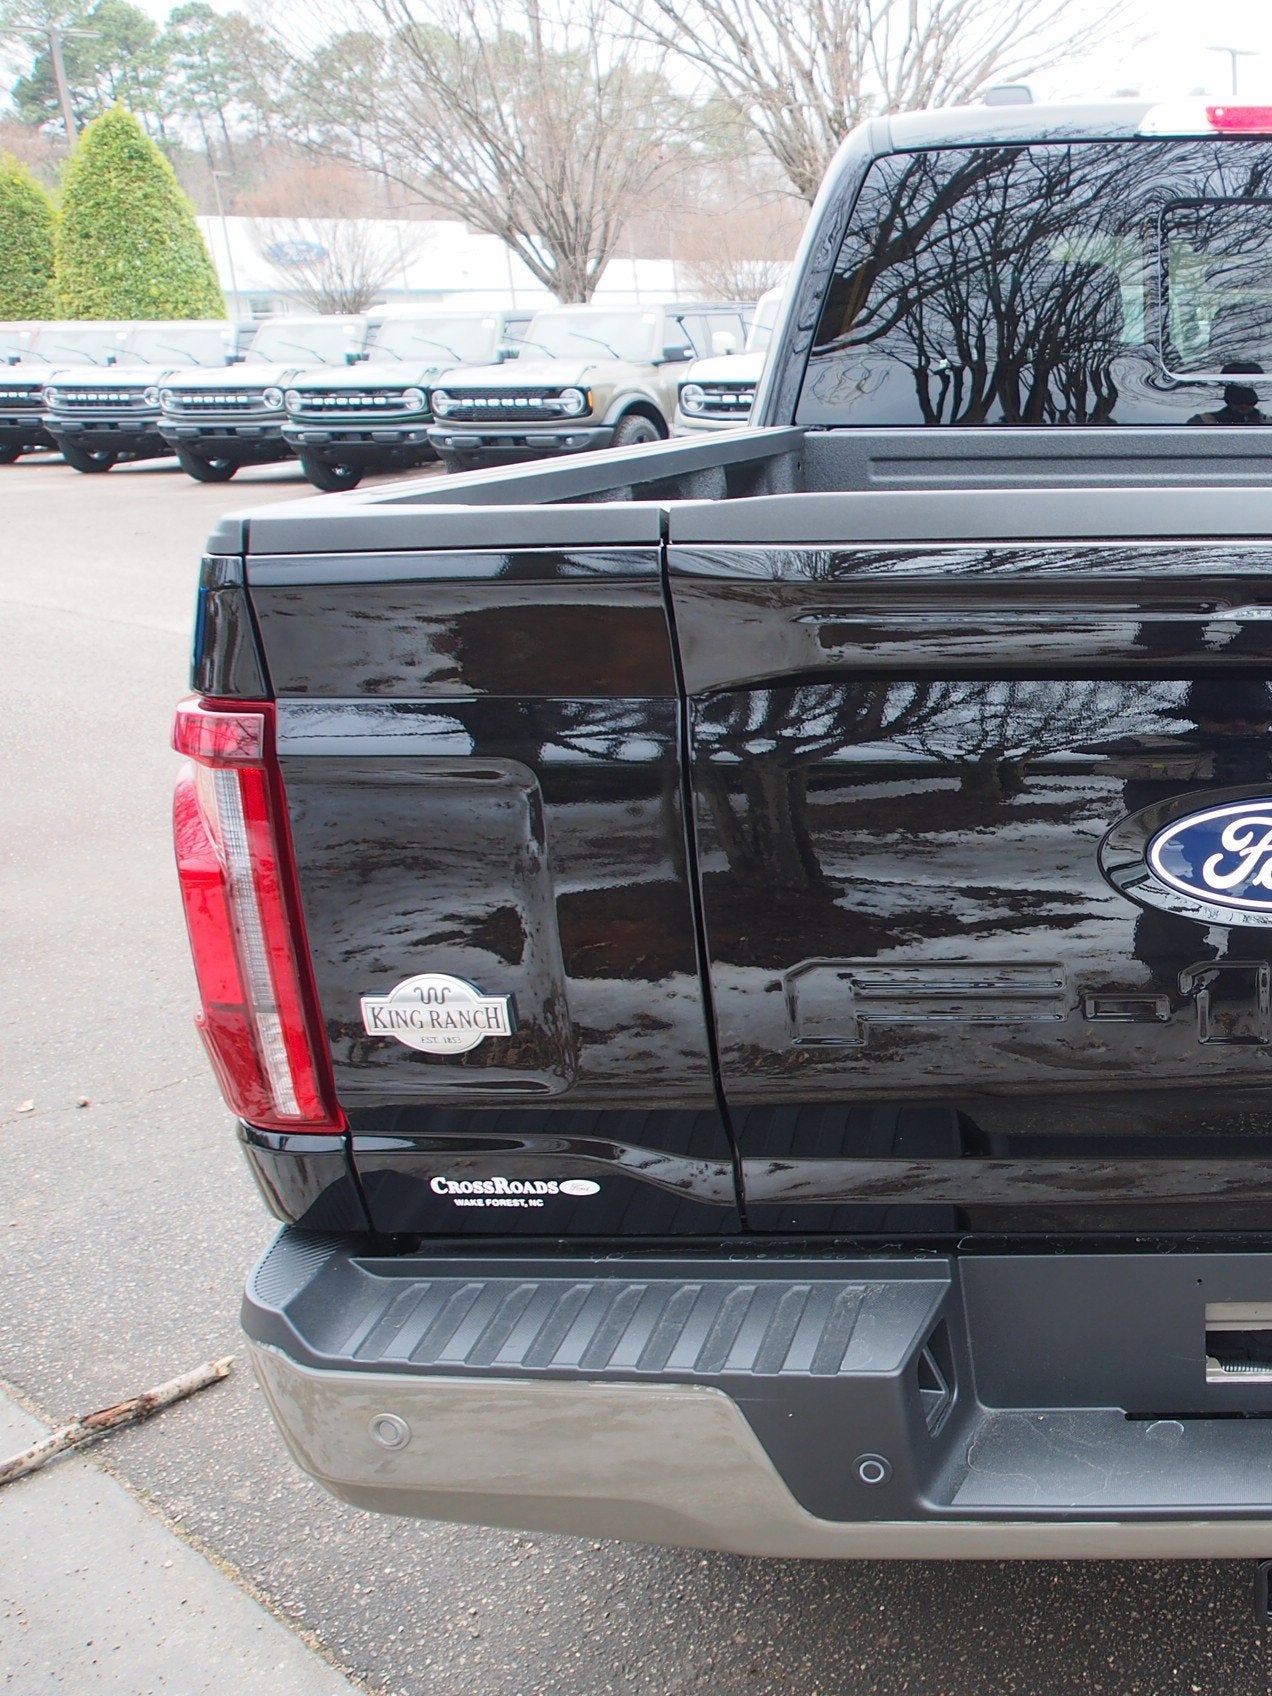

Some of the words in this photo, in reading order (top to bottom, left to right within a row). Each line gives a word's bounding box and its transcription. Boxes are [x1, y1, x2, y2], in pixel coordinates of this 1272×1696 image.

[371, 1006, 424, 1029] KING
[429, 1006, 501, 1029] RANCH
[443, 1035, 462, 1044] 1853
[453, 1198, 485, 1207] WAKE
[485, 1198, 528, 1208] FOREST,
[529, 1198, 545, 1207] NC
